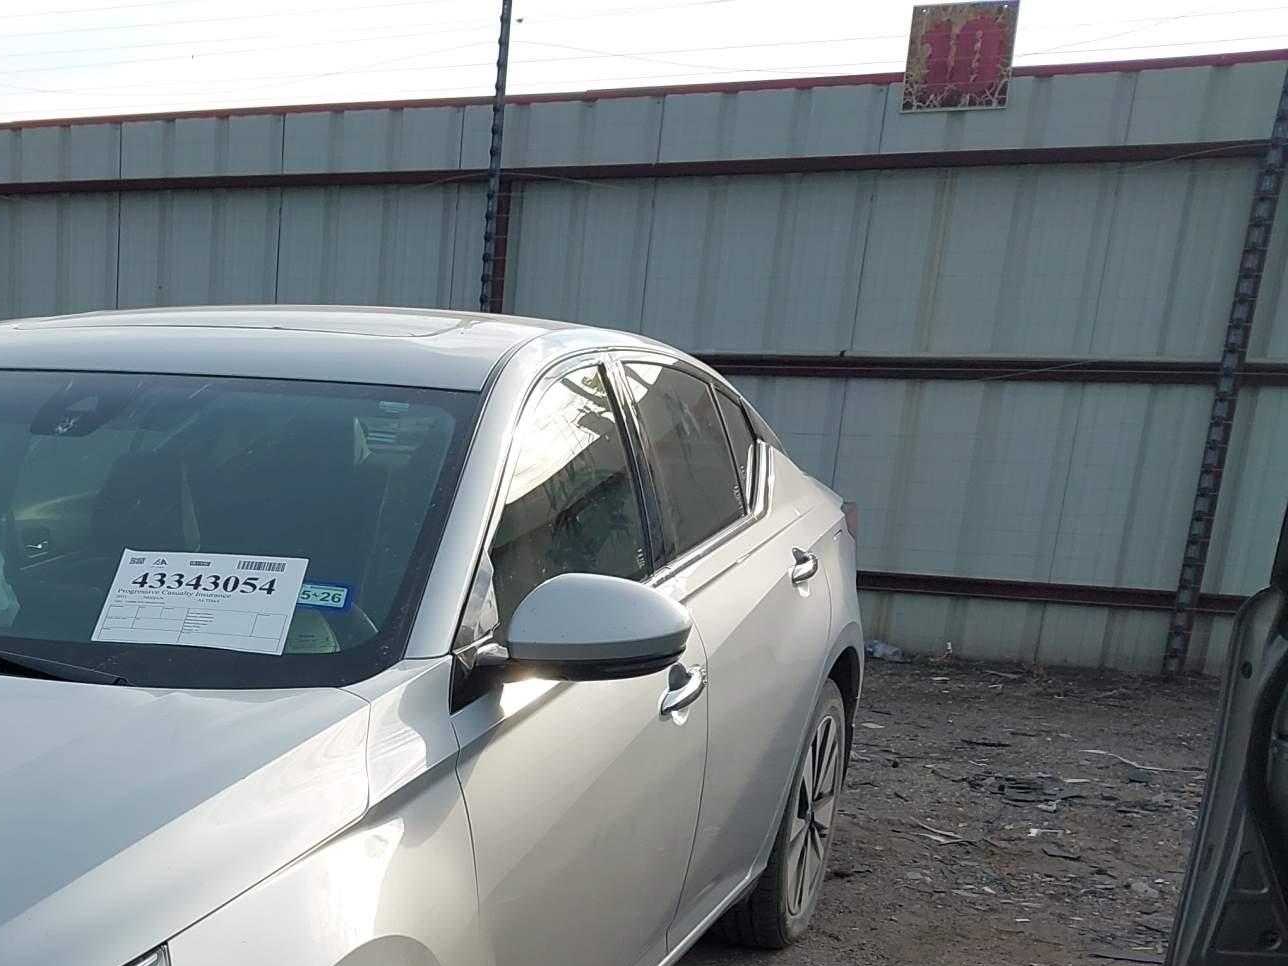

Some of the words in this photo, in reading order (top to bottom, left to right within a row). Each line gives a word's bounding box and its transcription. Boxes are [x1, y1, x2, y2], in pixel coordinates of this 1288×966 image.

[131, 571, 277, 596] 43343054
[161, 589, 194, 597] Casualty
[194, 591, 232, 599] Insurance
